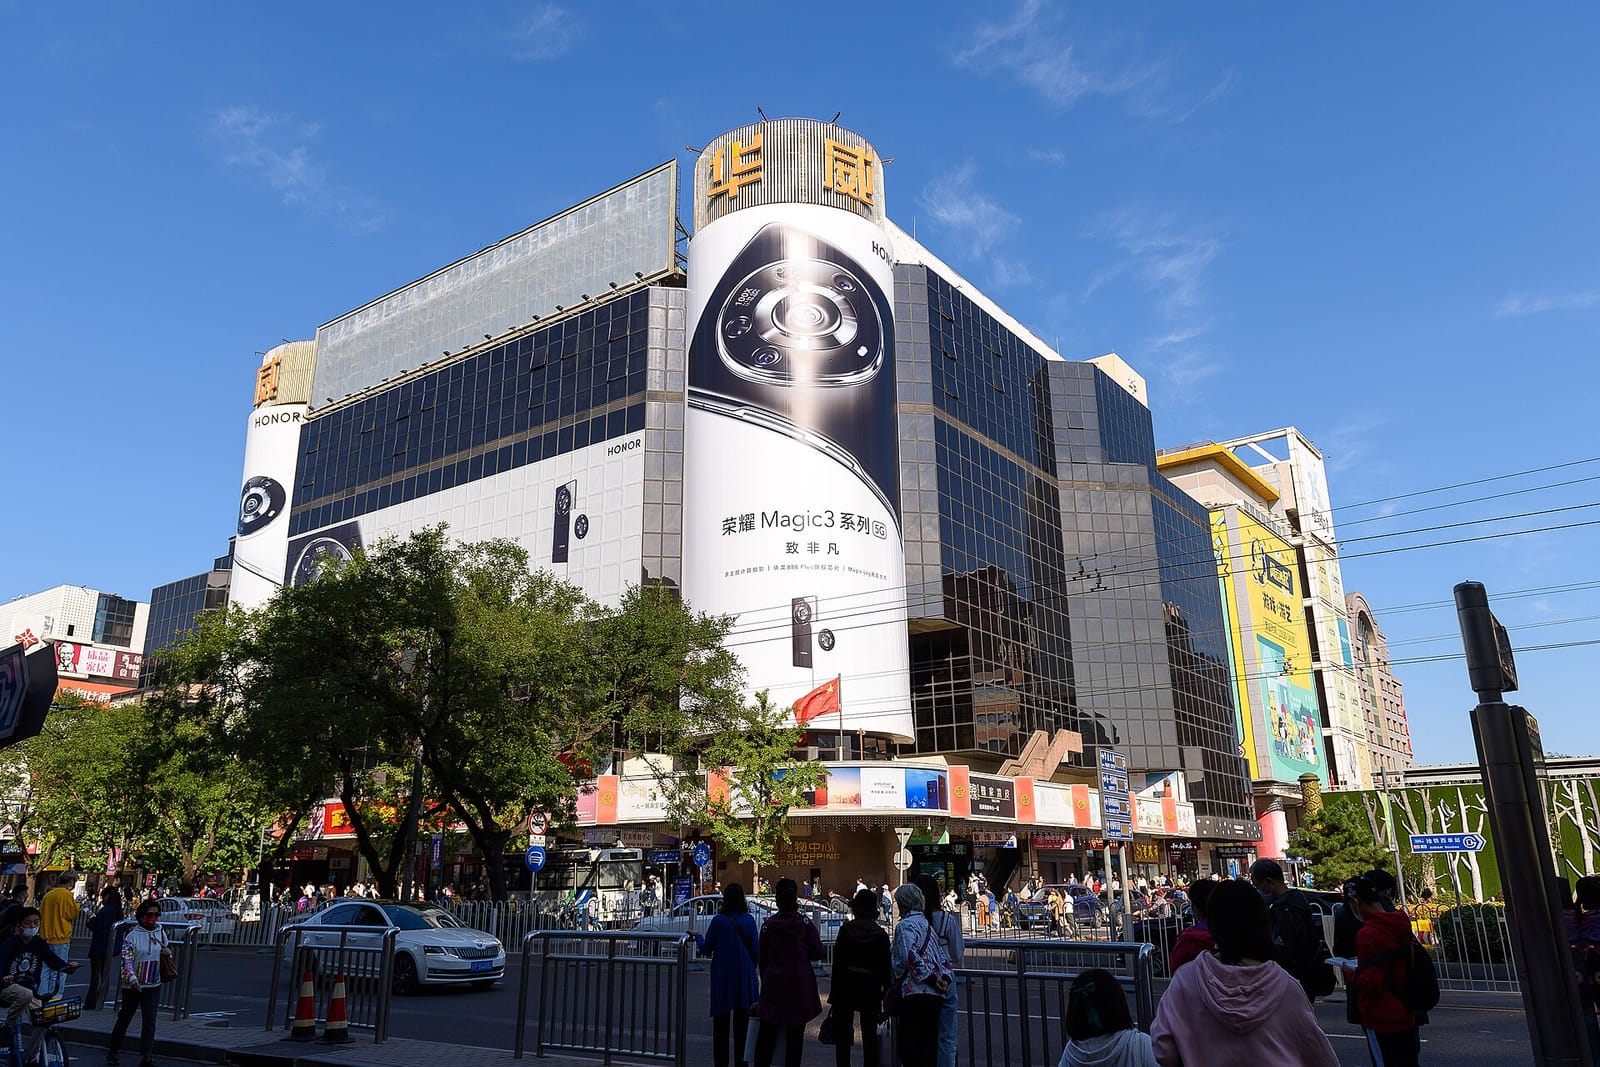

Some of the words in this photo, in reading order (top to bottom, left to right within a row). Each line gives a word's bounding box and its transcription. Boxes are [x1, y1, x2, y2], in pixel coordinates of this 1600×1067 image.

[708, 132, 874, 206] 华威
[735, 287, 753, 306] 100X
[253, 355, 281, 408] 威
[255, 411, 300, 428] HONOR
[607, 439, 641, 456] HONOR
[721, 513, 756, 536] 荣耀
[761, 510, 835, 532] Magic3
[839, 512, 870, 535] 系列
[874, 524, 886, 537] 5G
[785, 541, 840, 555] 致非凡
